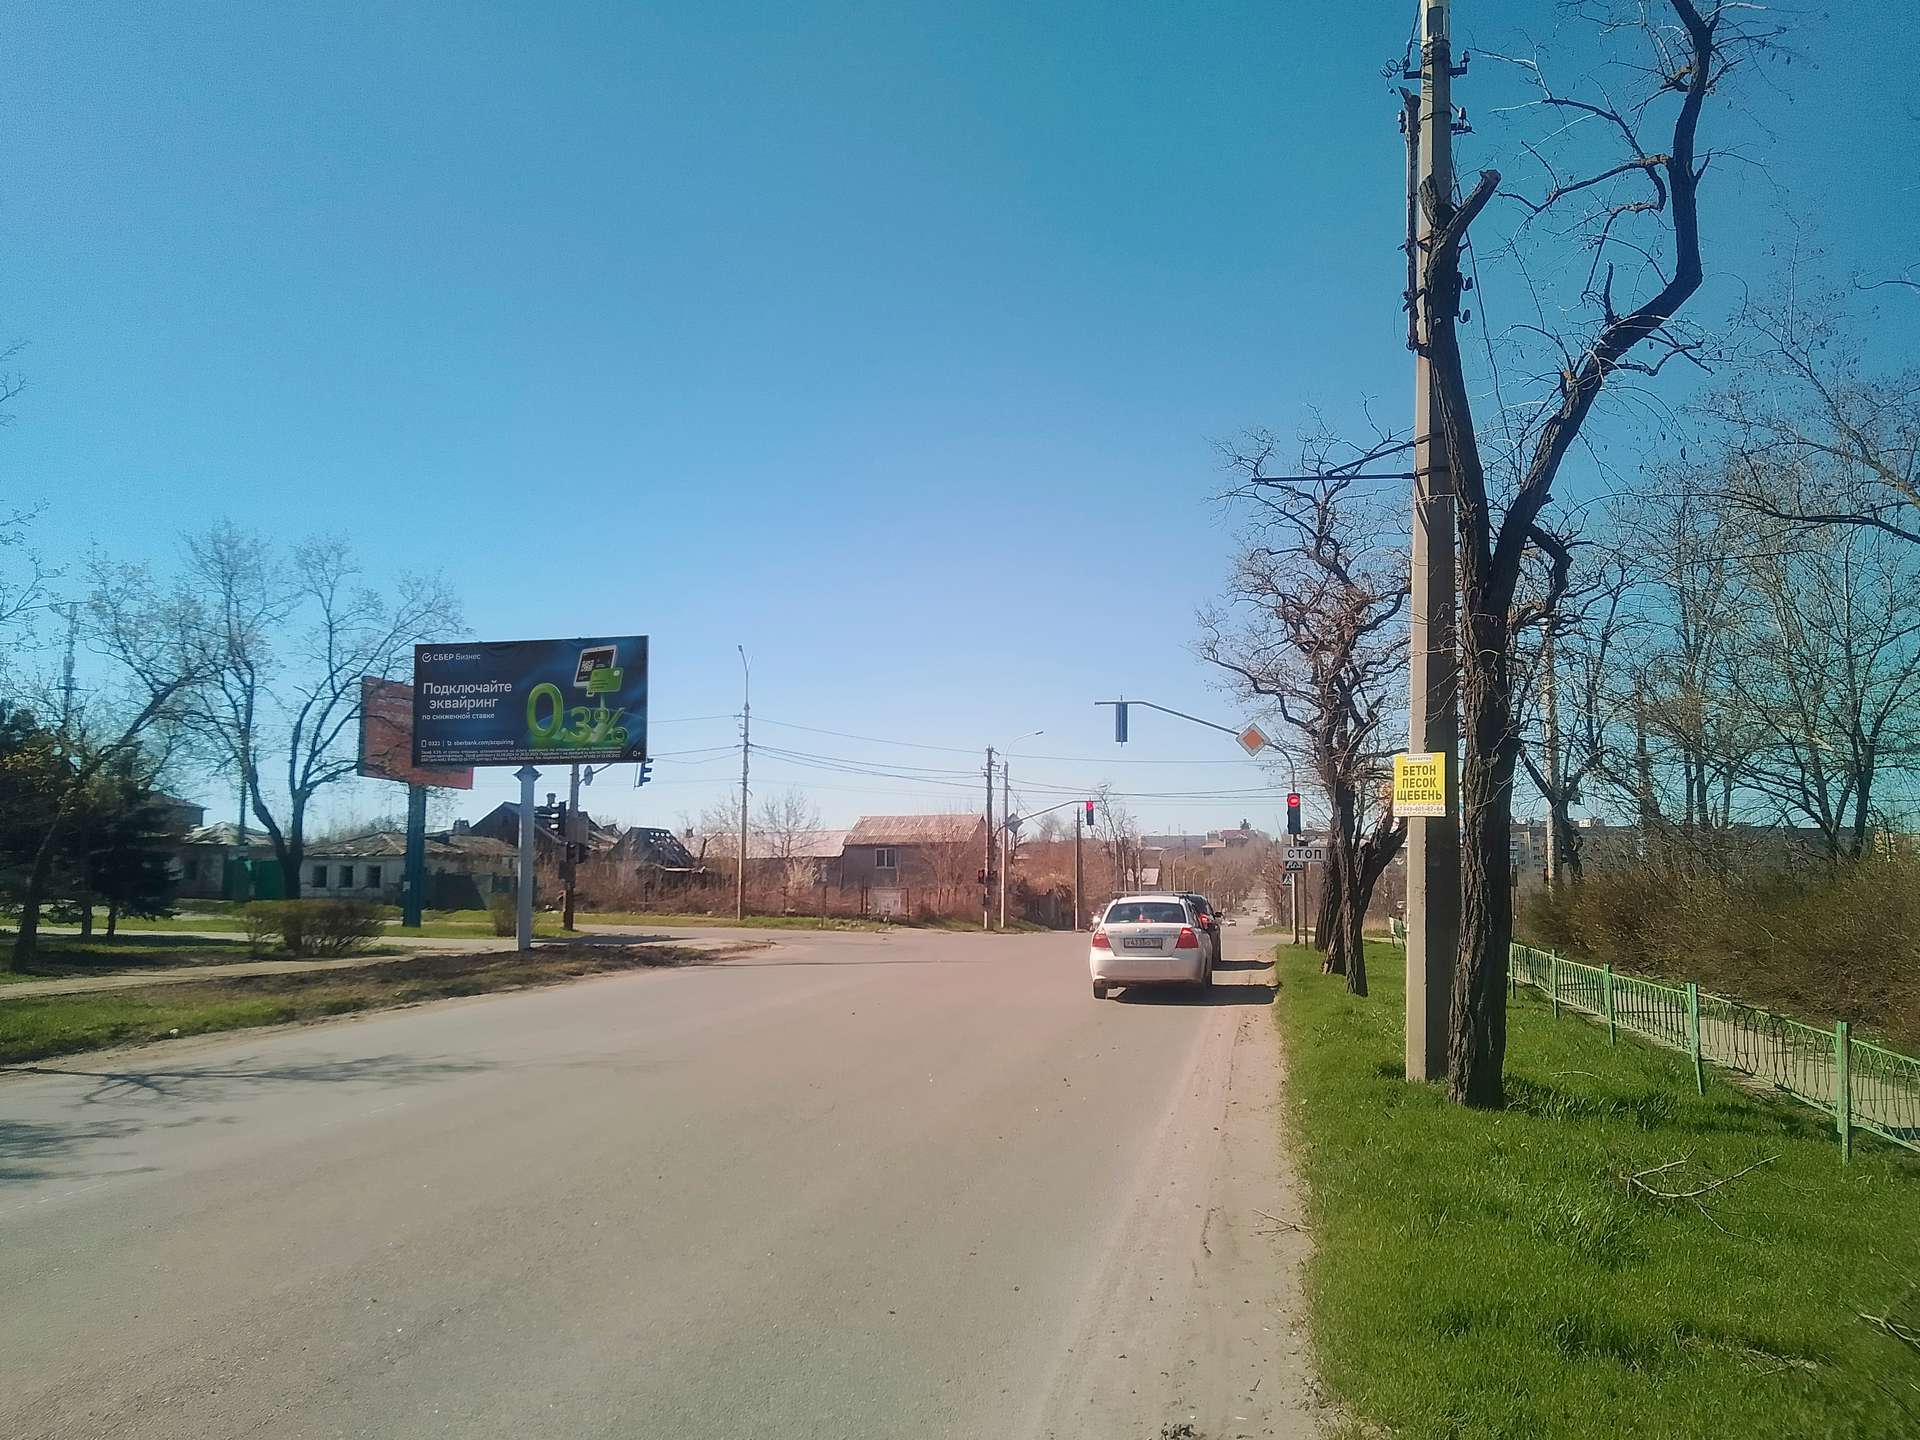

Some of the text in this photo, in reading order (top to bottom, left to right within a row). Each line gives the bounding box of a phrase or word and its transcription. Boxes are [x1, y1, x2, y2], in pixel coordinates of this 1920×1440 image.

[433, 652, 481, 661] СБЕР Бизнес
[423, 680, 512, 696] Подключайте
[429, 697, 499, 711] эквайринг
[432, 712, 471, 720] сниженной
[472, 712, 495, 720] ставке
[1402, 765, 1436, 776] БЕТОН
[1402, 777, 1437, 789] ПЕСОК
[1396, 790, 1443, 802] ЩЕБЕНЬ
[1287, 849, 1322, 860] СТОП
